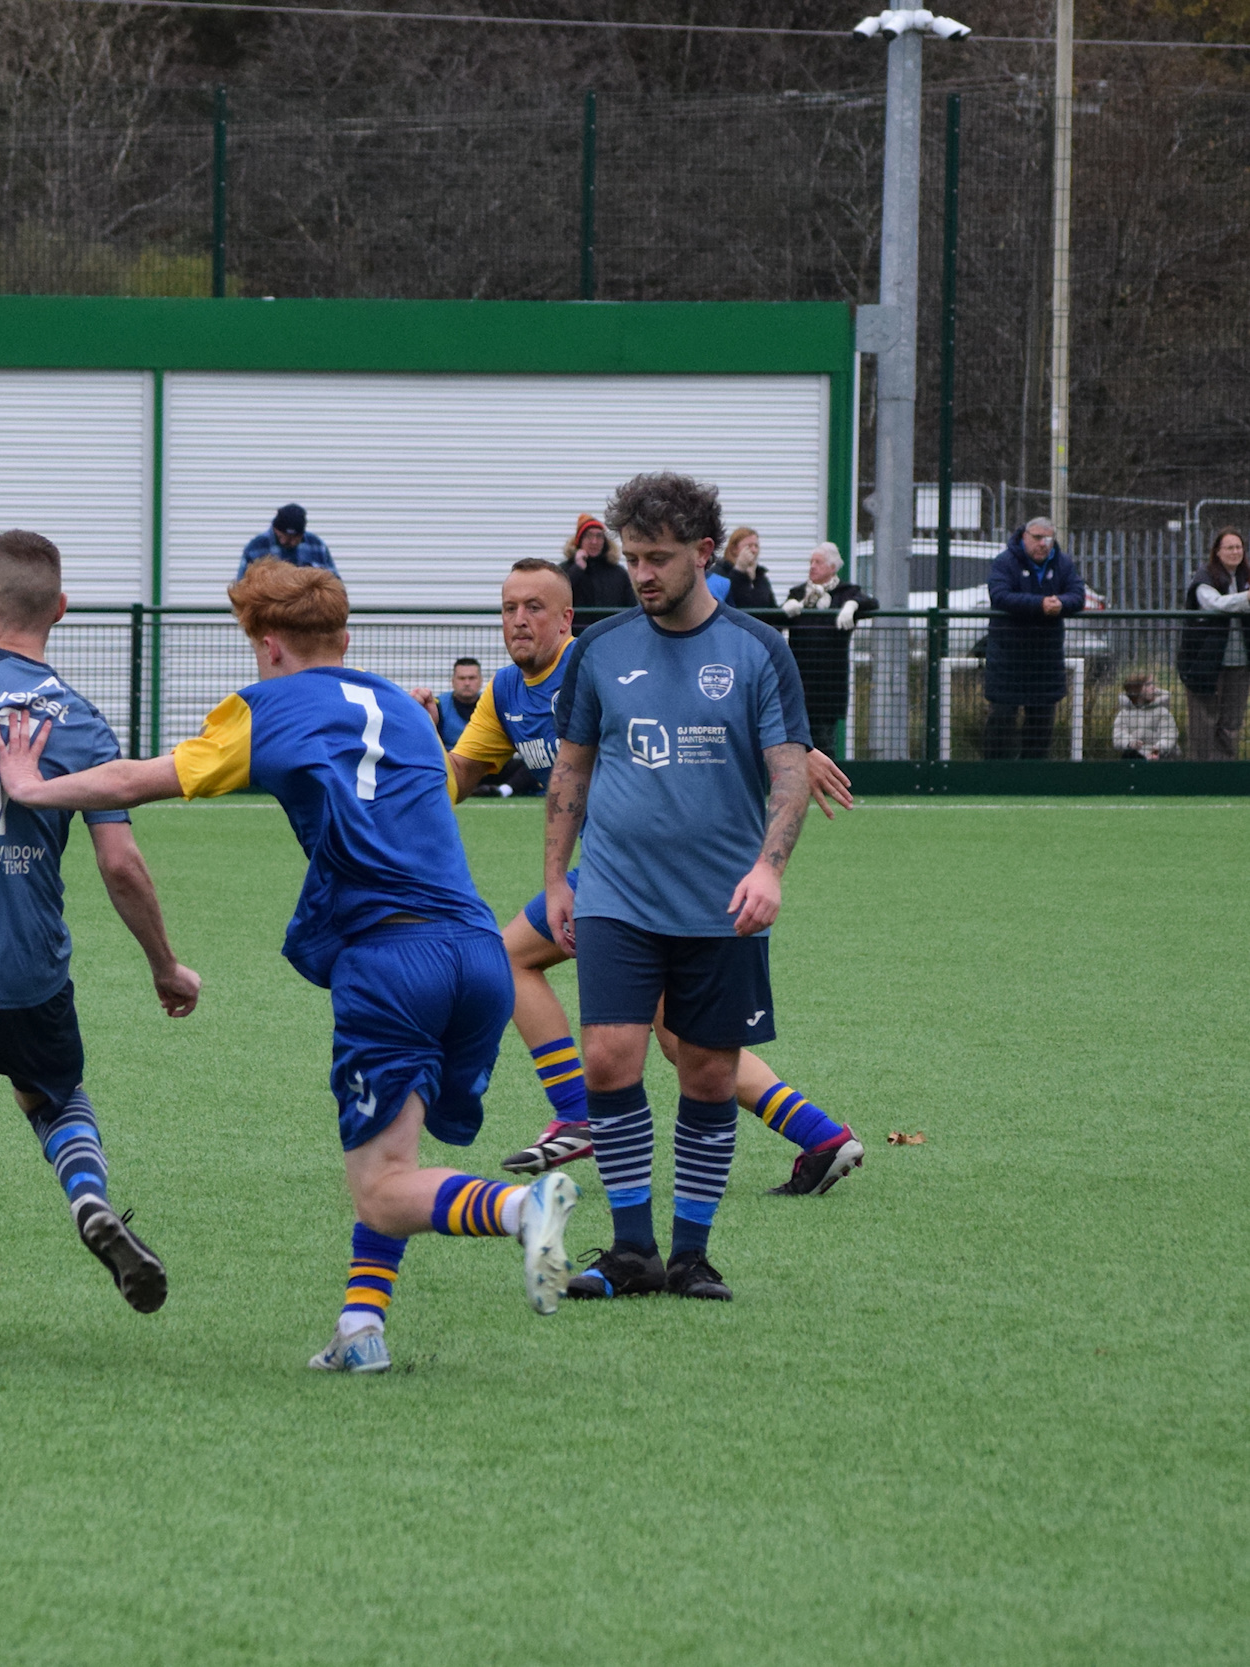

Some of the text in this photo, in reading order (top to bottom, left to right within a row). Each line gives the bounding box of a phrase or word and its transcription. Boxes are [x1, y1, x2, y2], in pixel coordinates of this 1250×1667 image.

[677, 726, 727, 735] GJ PROPERTY
[339, 682, 385, 801] 7
[677, 735, 727, 744] MAINTENANCE
